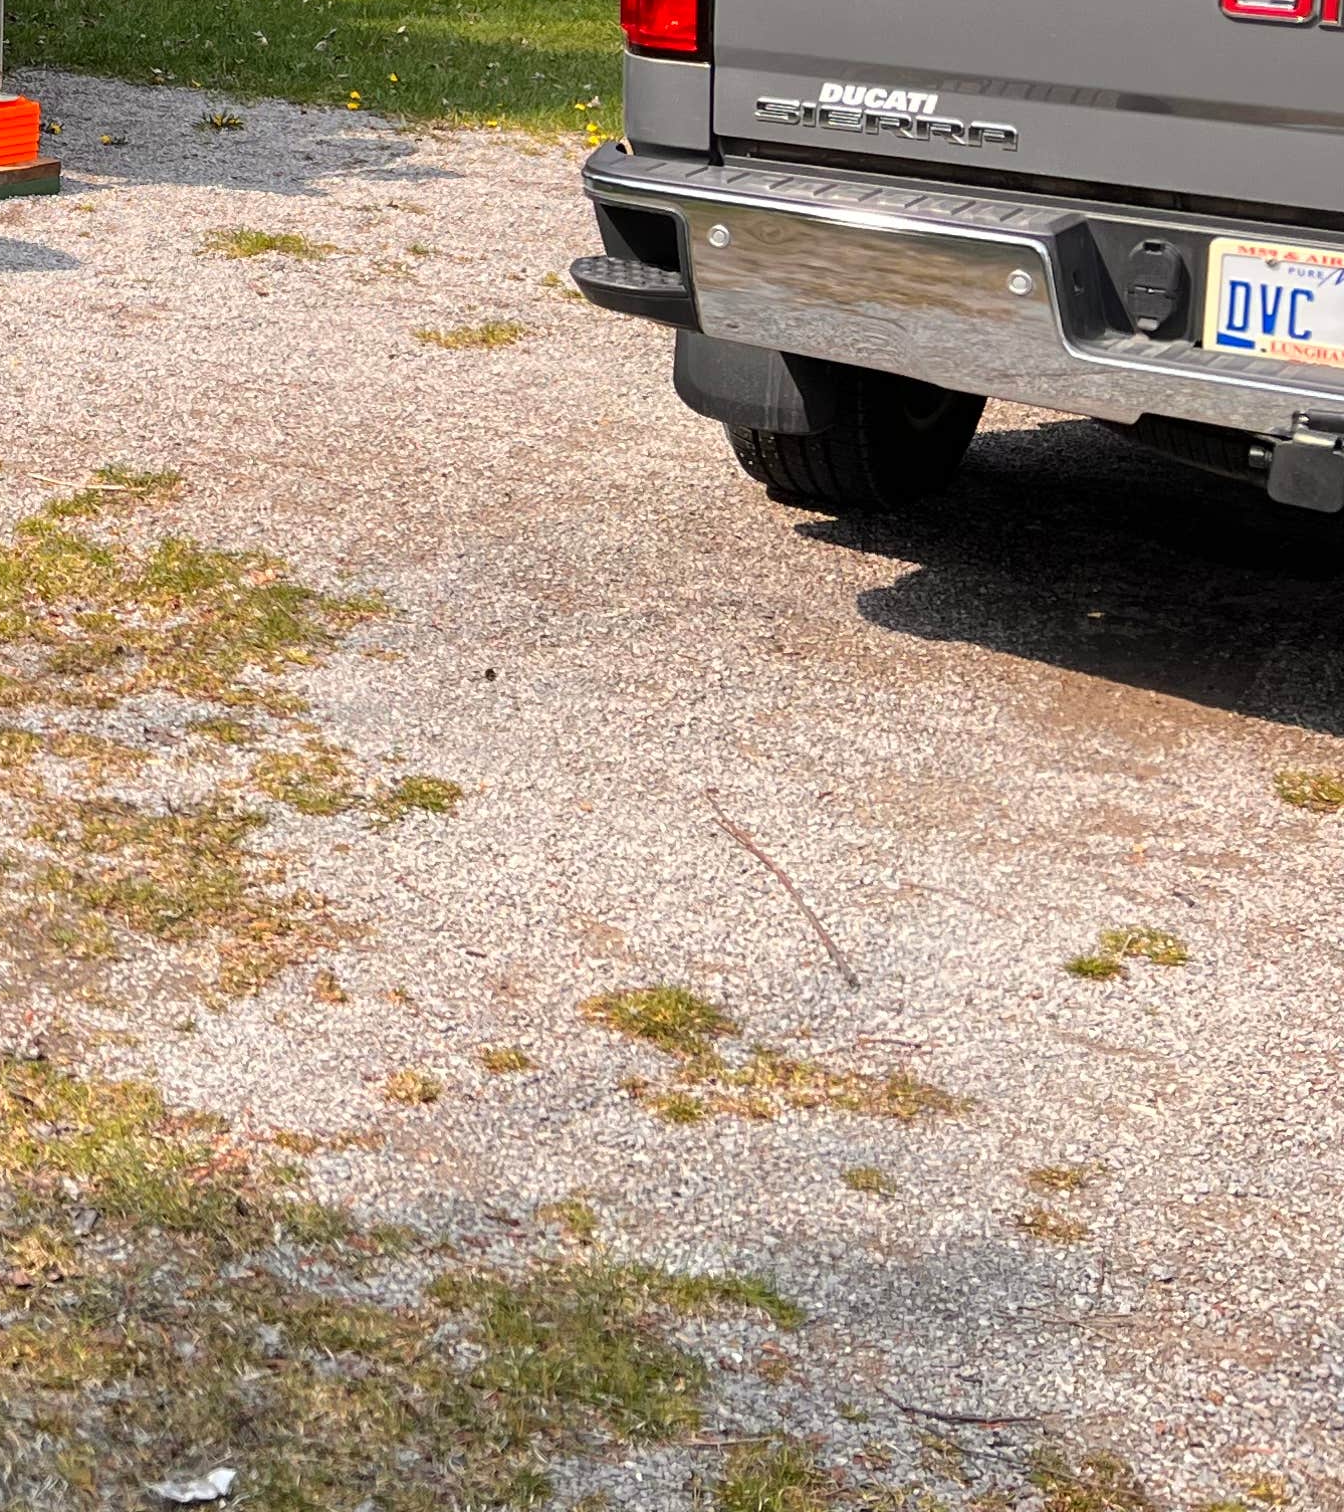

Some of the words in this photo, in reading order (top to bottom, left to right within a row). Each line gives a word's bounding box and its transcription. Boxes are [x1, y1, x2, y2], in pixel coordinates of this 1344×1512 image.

[819, 82, 938, 114] DUCATI
[754, 97, 1019, 152] SIERRA
[1284, 251, 1300, 261] &
[1288, 267, 1325, 280] PURE
[1226, 279, 1315, 341] DVC
[1270, 340, 1344, 362] LUNGHA
